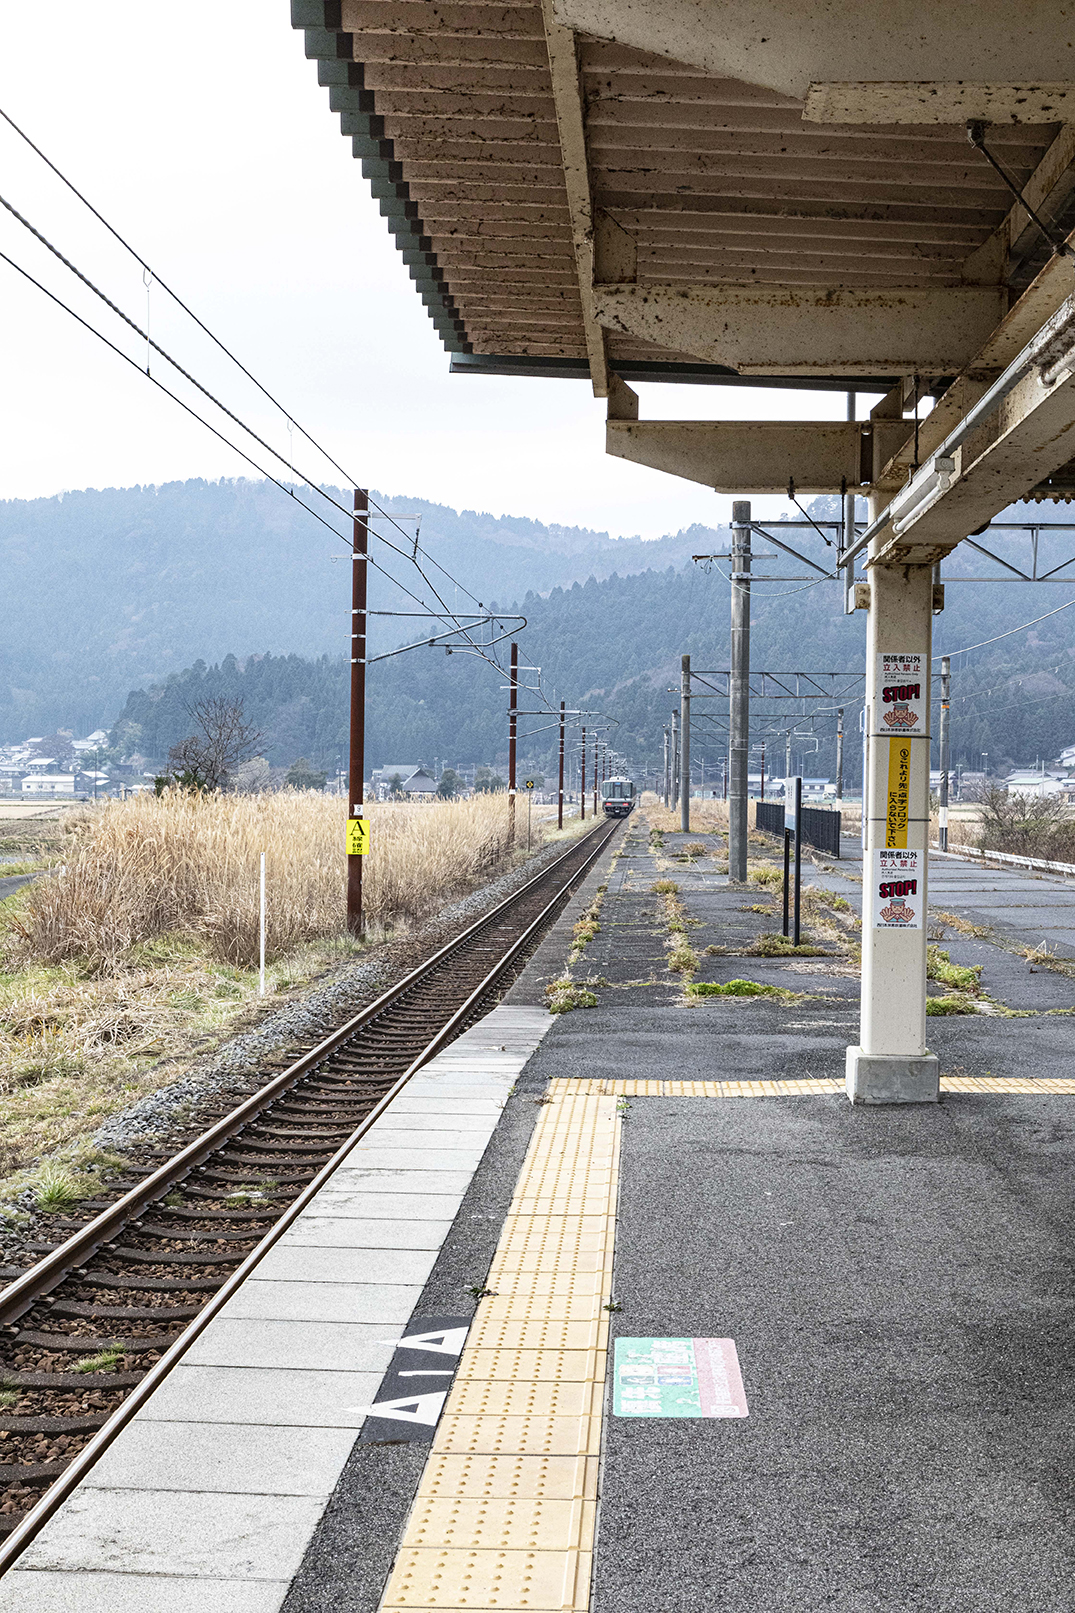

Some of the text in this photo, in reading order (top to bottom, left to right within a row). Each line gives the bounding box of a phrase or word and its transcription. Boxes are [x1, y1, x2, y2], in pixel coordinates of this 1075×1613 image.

[883, 655, 921, 664] 関係者以外
[883, 664, 921, 672] 立入禁止
[882, 683, 921, 703] STOP!
[887, 791, 898, 847] に入らないで下さい
[350, 821, 366, 836] A
[879, 851, 918, 859] 関係者以外
[879, 859, 918, 868] 立入禁止
[879, 879, 918, 898] STOP!
